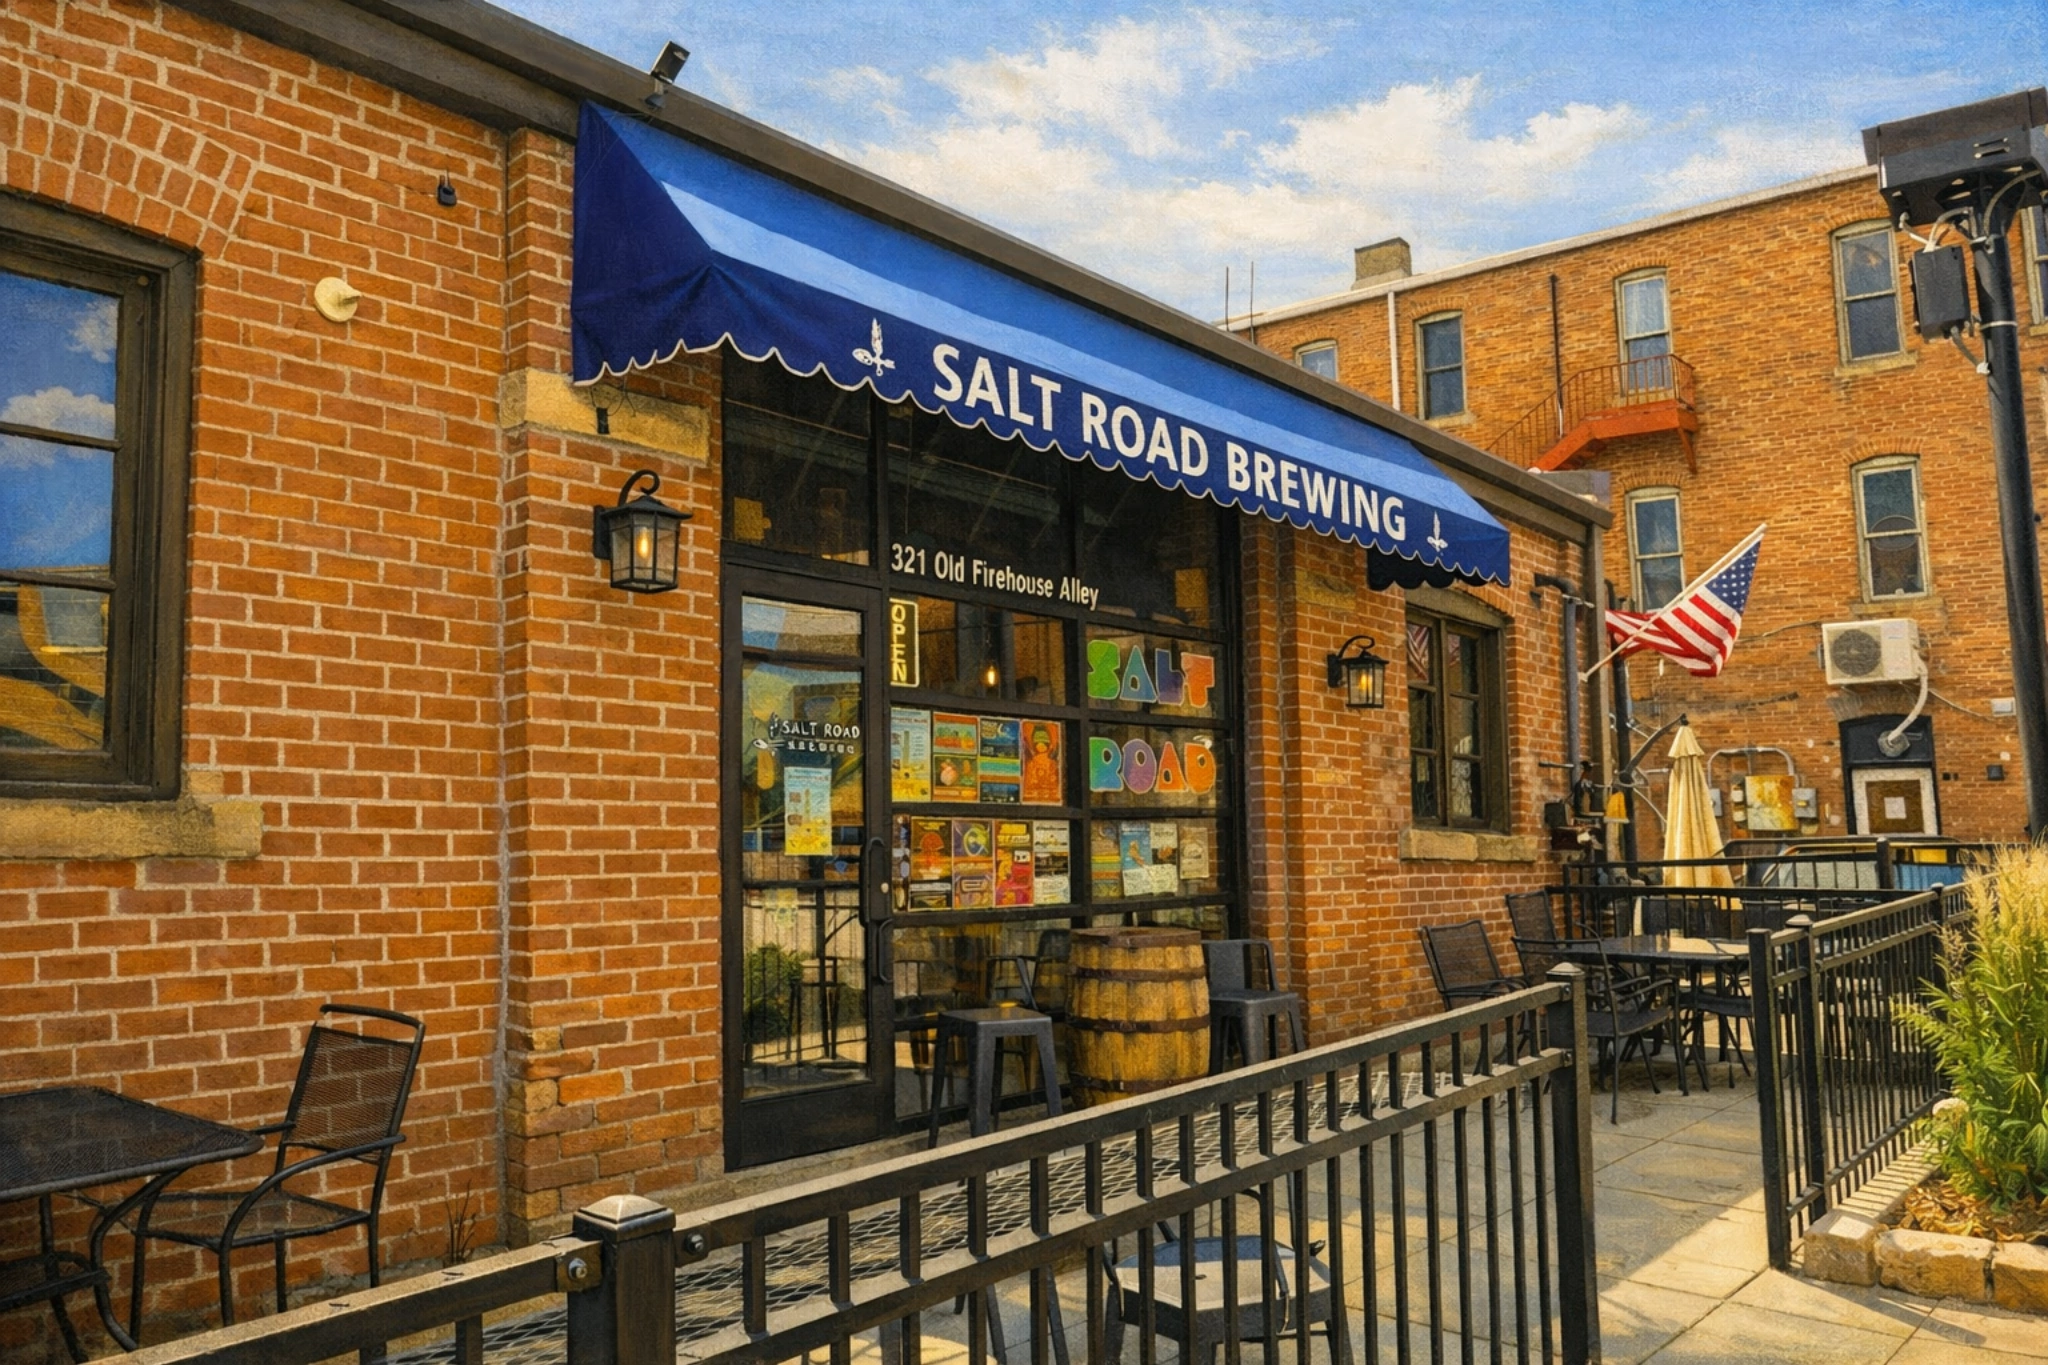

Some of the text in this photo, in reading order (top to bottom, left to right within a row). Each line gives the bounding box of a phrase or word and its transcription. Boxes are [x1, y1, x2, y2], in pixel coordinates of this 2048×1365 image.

[932, 343, 1406, 542] SALT ROAD BREWING
[891, 543, 1099, 611] 321 Old Firehouse Alley
[891, 604, 907, 682] OPEN
[1087, 640, 1215, 708] SALT
[781, 720, 860, 738] SALT ROAD
[1089, 737, 1216, 794] ROAD
